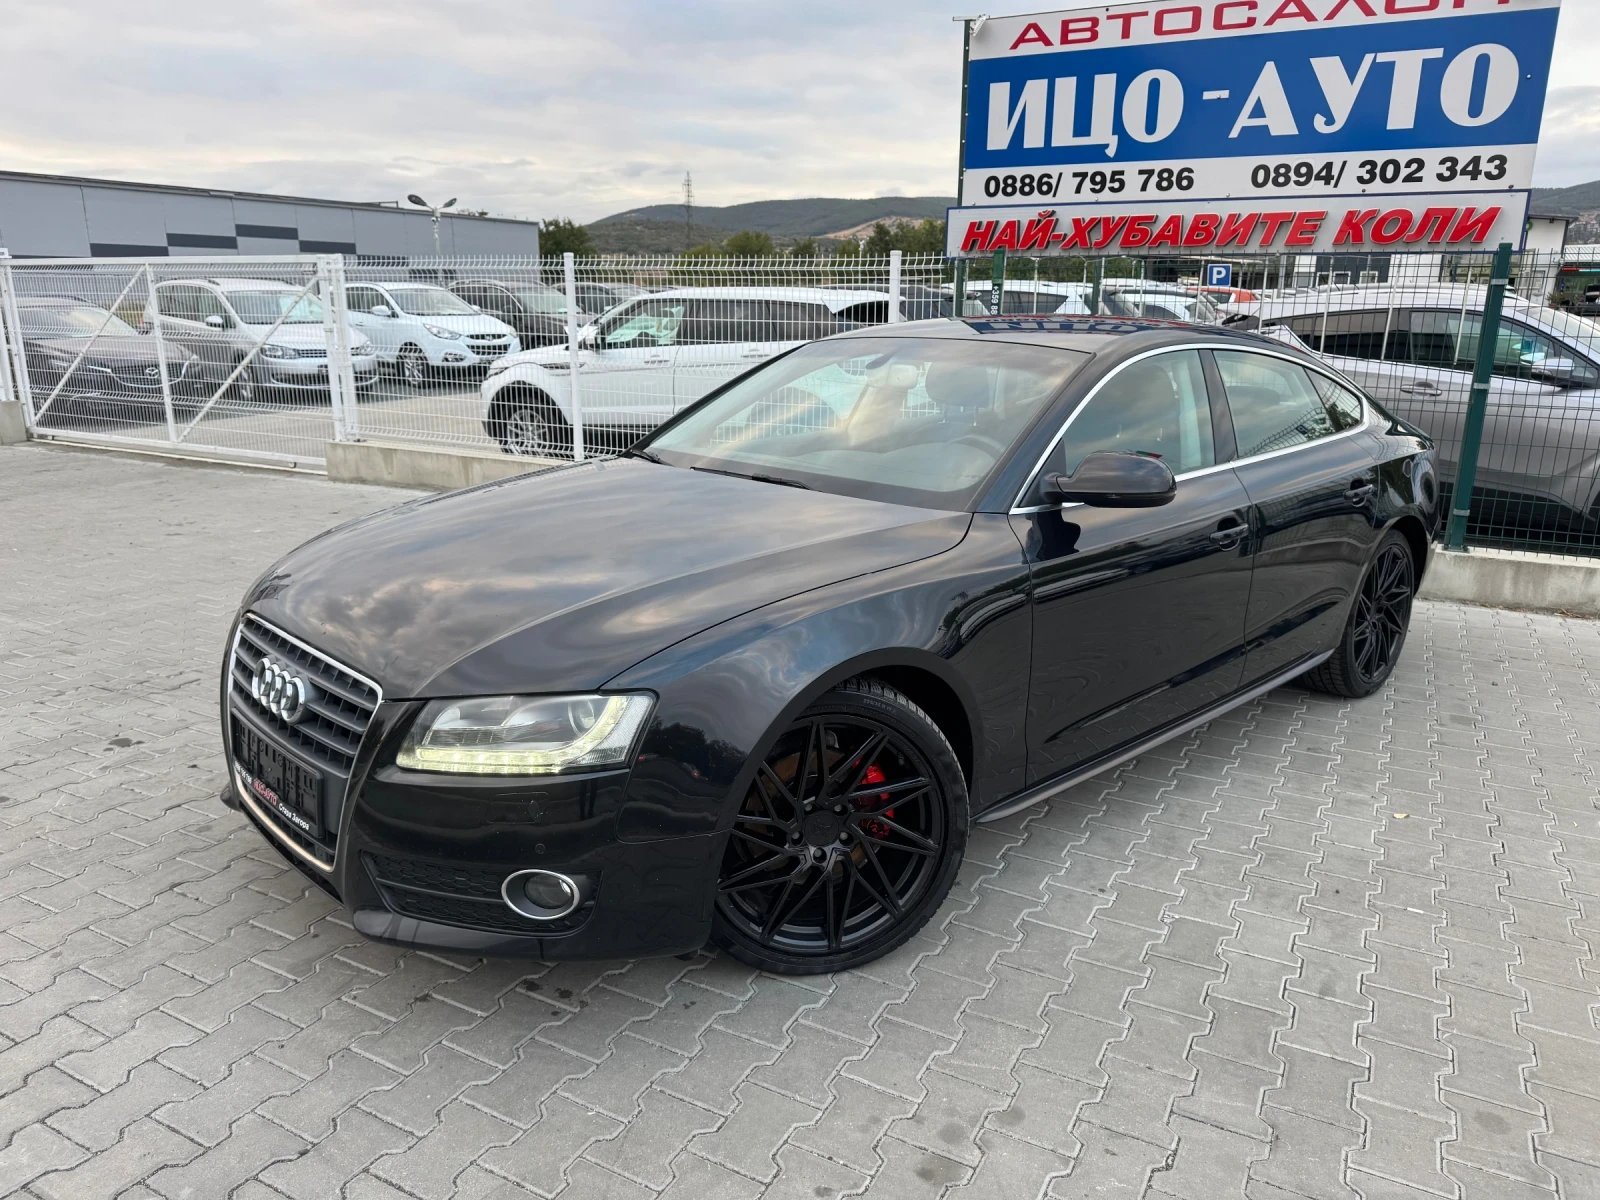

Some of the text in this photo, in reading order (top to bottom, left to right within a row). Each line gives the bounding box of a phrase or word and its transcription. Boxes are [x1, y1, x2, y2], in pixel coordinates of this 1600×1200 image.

[984, 167, 1195, 197] 0886/ 795 786
[1251, 154, 1508, 188] 0894/ 302 343
[960, 206, 1503, 251] НАЙ-ХУБАВИТЕ КОЛИ
[1212, 267, 1227, 284] P
